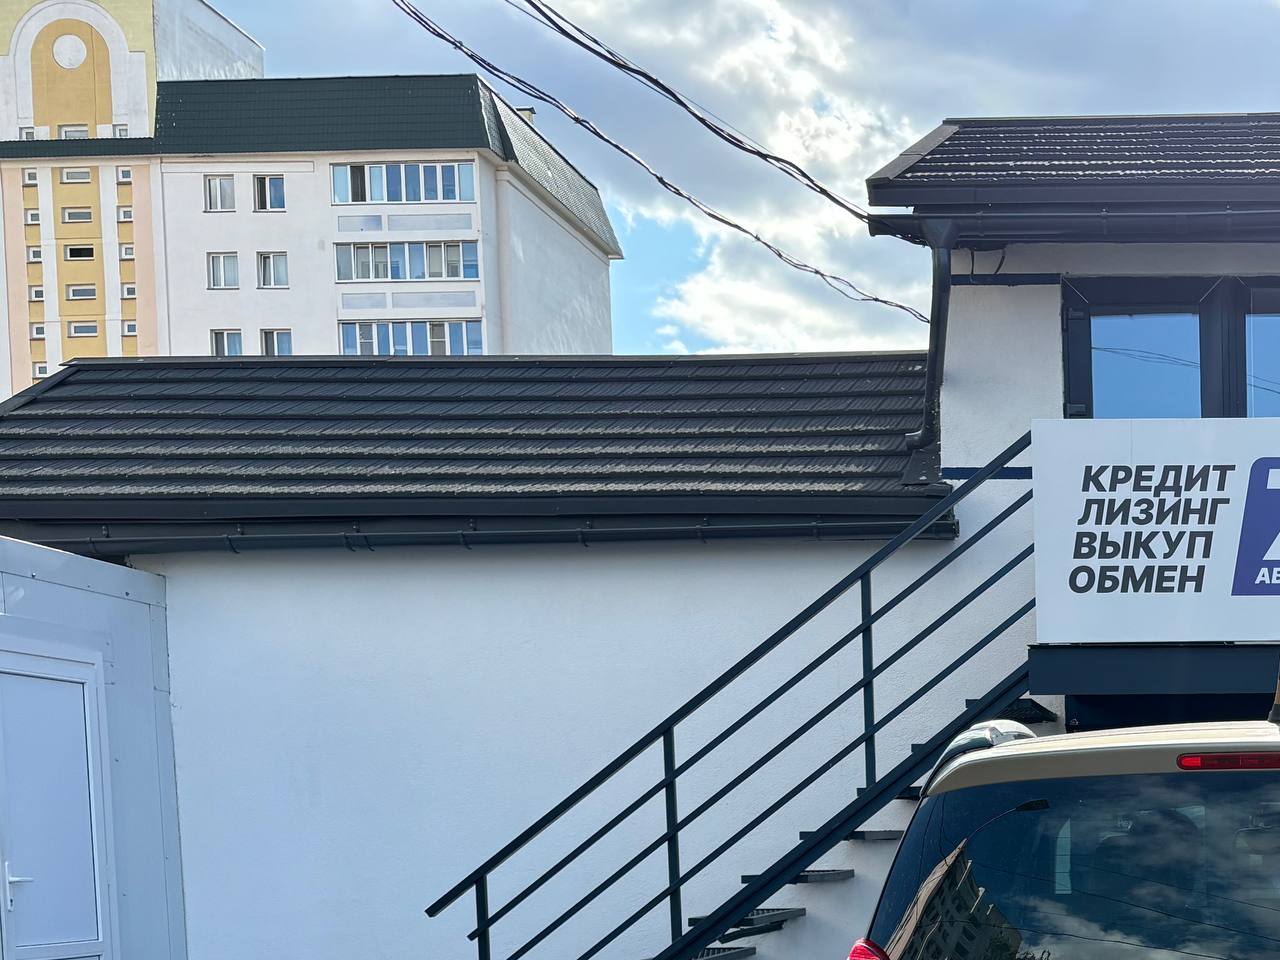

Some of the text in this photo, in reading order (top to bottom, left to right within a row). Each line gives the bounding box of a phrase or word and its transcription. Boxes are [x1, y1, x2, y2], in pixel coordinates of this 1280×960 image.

[1081, 464, 1236, 497] КРЕДИТ
[1077, 497, 1230, 526] ЛИЗИНГ
[1072, 530, 1214, 559] ВЫКУП
[1068, 564, 1206, 594] ОБМЕН
